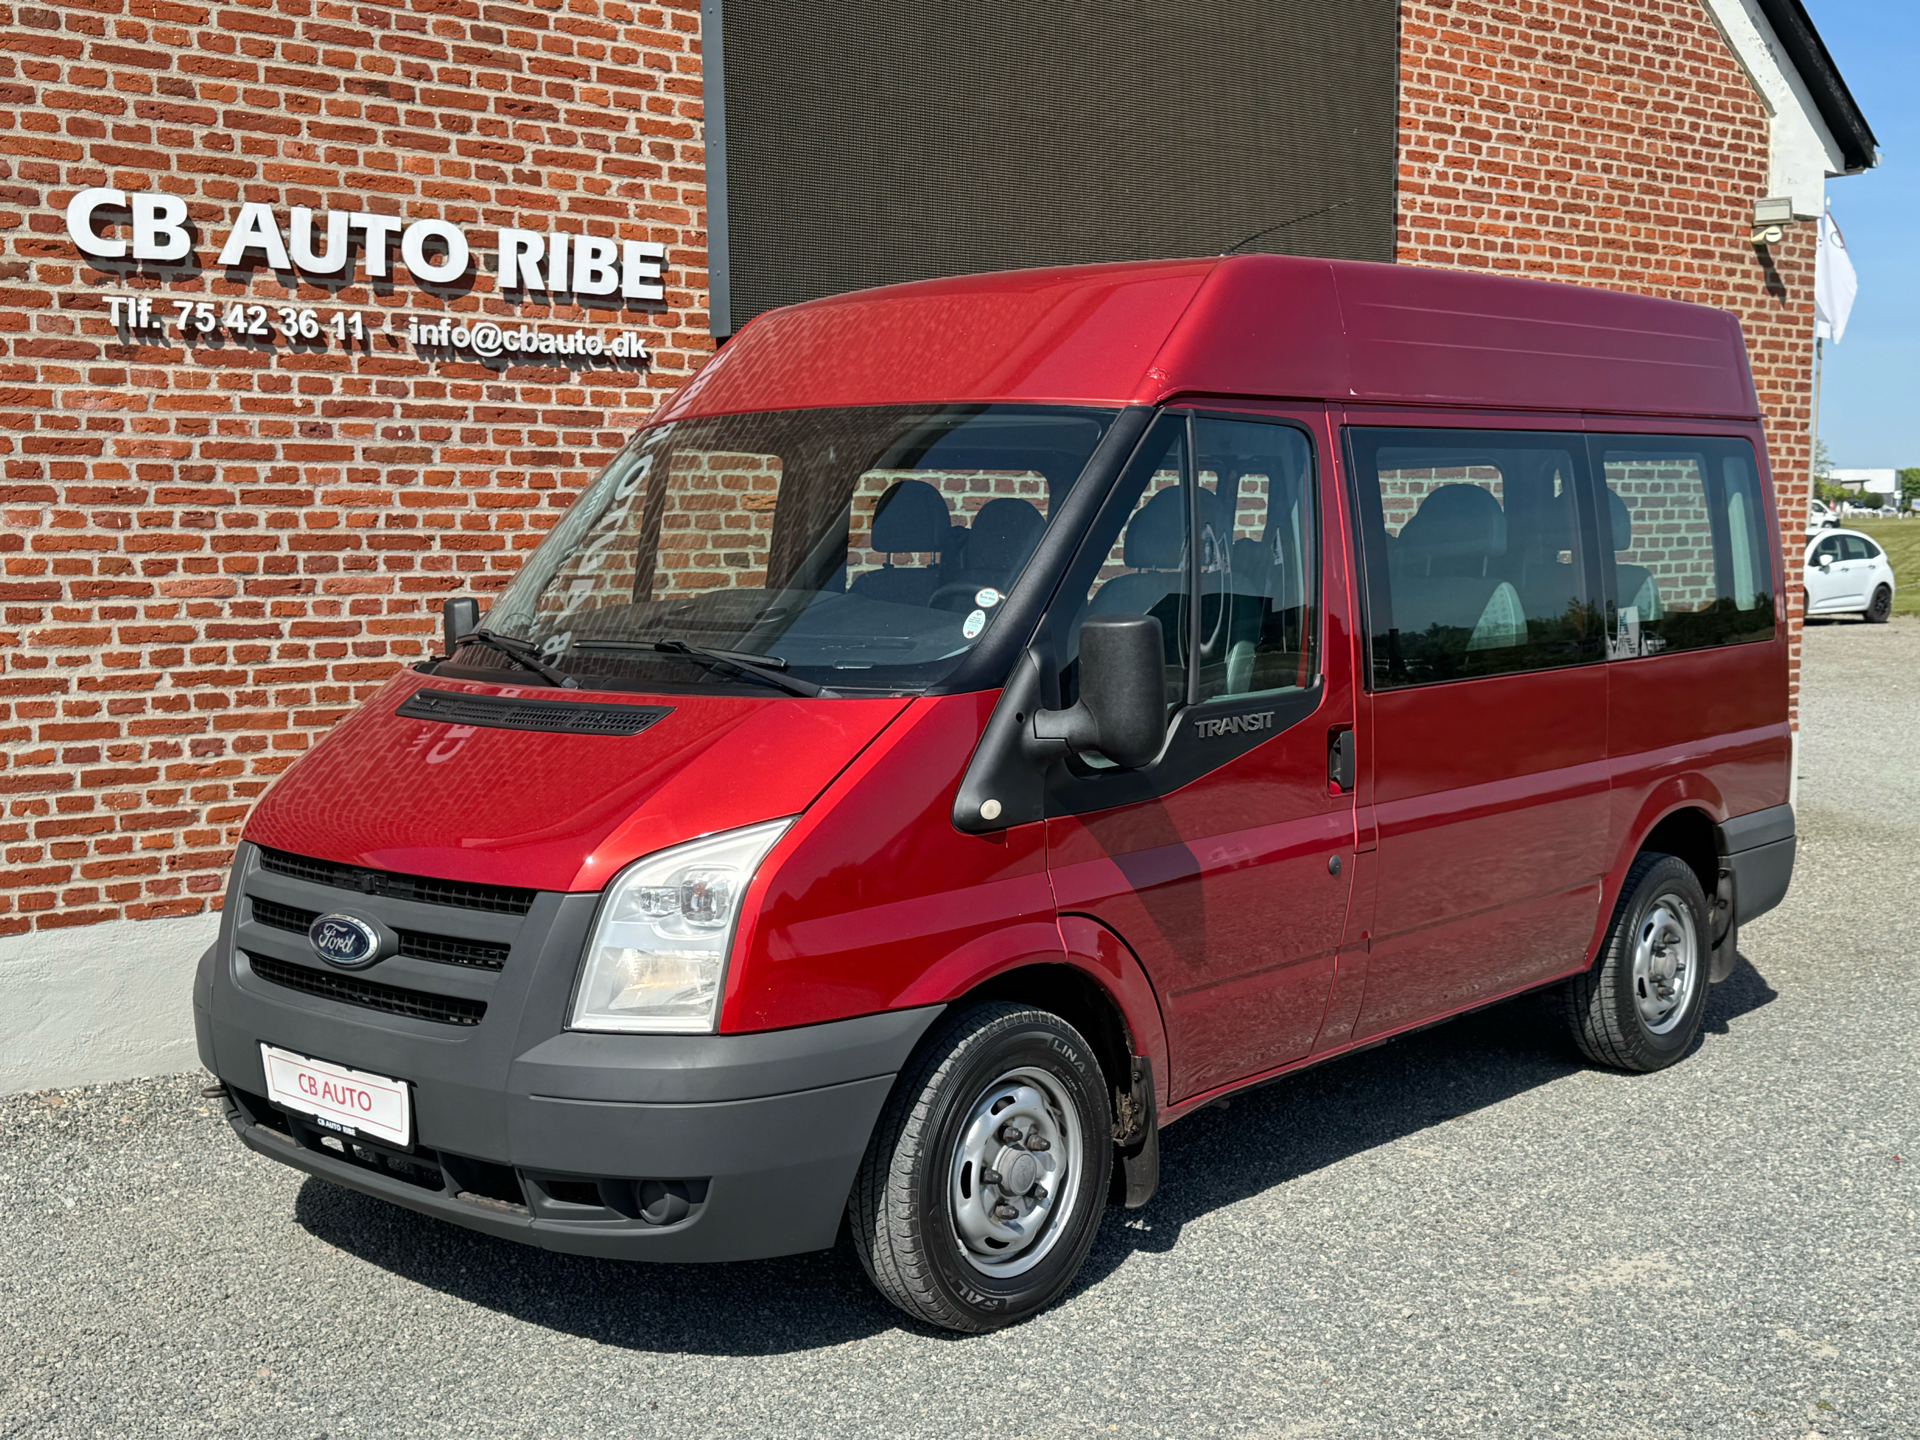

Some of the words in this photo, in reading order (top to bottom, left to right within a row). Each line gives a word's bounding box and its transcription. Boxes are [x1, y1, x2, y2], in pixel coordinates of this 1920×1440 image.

[66, 188, 191, 259] CB
[218, 202, 470, 283] AUTO
[497, 228, 664, 299] RIBE
[103, 296, 161, 330] Tlf.
[173, 299, 215, 332] 75
[228, 304, 268, 335] 42
[280, 307, 318, 340] 36
[332, 311, 363, 341] 11
[409, 317, 647, 359] info@cbauto.dk
[1195, 711, 1275, 738] TRANSIT
[318, 922, 356, 953] Ford
[298, 1073, 318, 1096] CB
[322, 1081, 372, 1111] AUTO
[325, 1120, 342, 1131] AUTO
